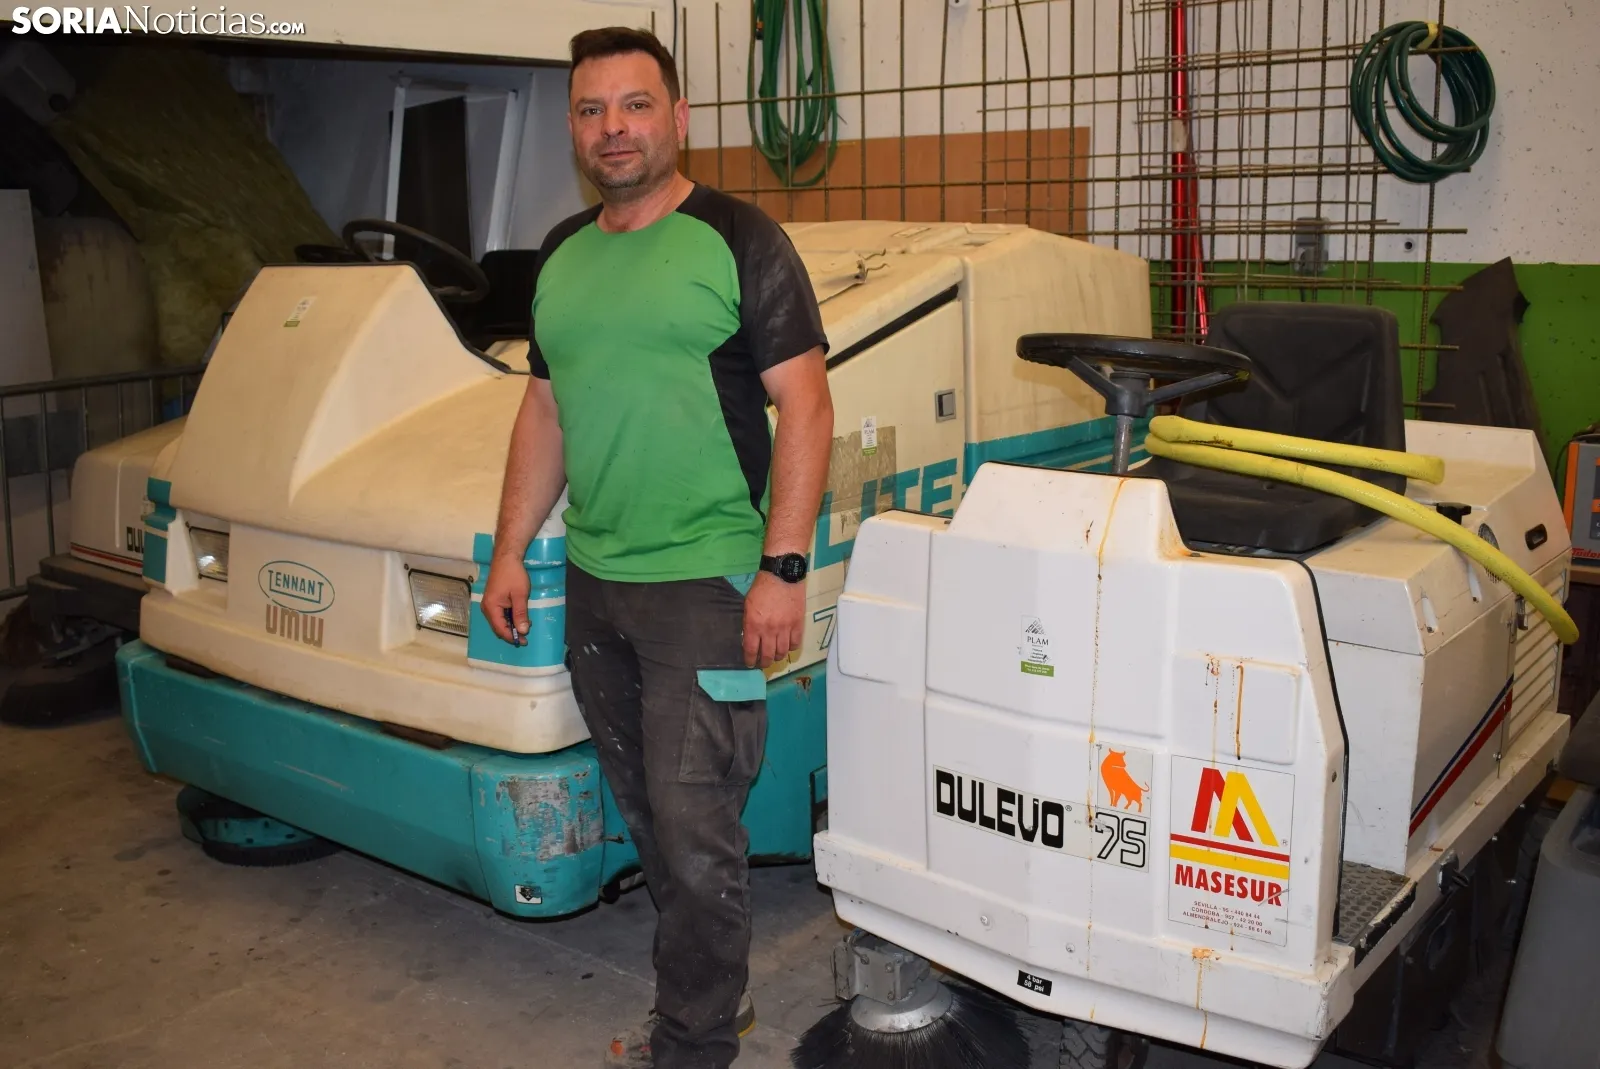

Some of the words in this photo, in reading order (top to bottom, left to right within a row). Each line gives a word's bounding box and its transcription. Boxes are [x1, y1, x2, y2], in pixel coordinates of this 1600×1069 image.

[268, 569, 325, 604] TENNANT
[1027, 635, 1049, 646] PLAM
[1094, 811, 1148, 868] 75
[1174, 863, 1283, 907] MASESUR
[1193, 900, 1218, 911] SEVILLA
[1191, 906, 1220, 917] CORDOBA
[1182, 910, 1229, 926] ALMENDRALEJO
[1032, 976, 1042, 984] bar
[1034, 984, 1044, 992] psi
